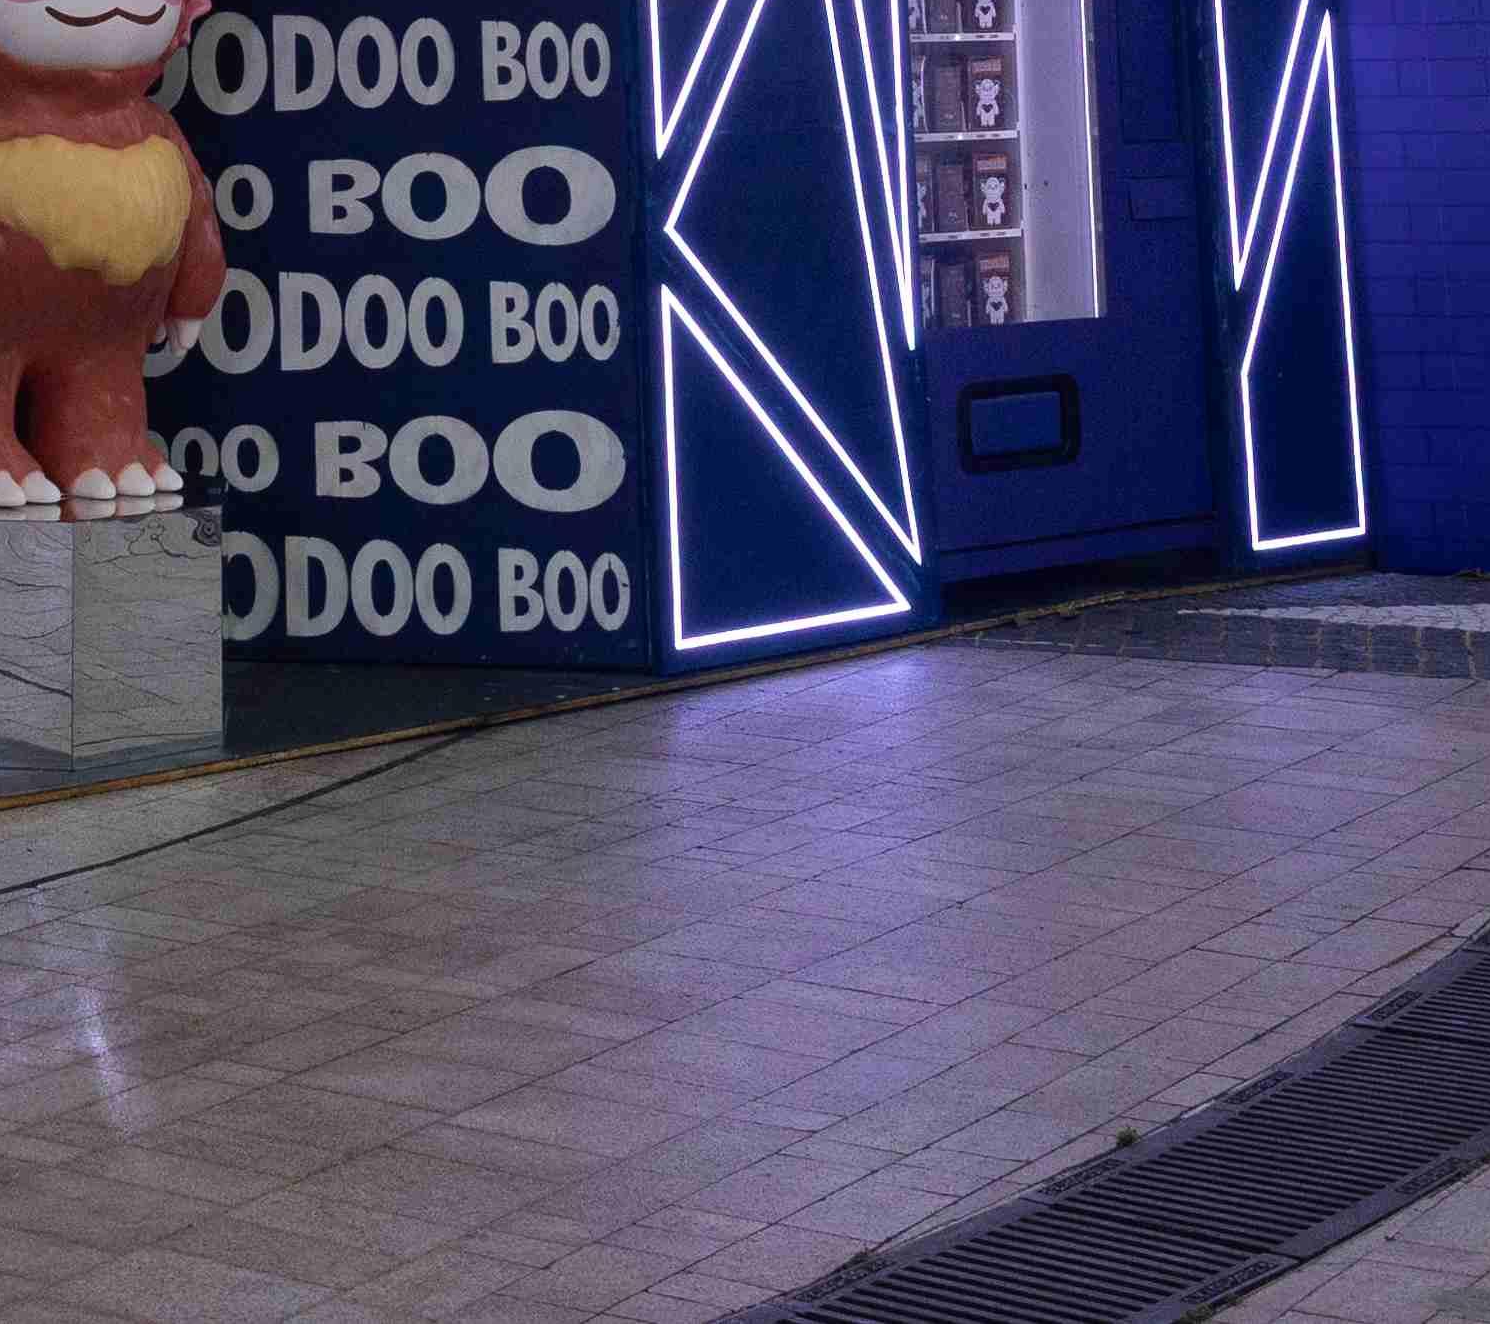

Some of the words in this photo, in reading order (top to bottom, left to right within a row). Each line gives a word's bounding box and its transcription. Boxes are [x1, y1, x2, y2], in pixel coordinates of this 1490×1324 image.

[150, 11, 456, 117] ODOO
[482, 19, 612, 102] BOO
[309, 145, 617, 246] BOO
[490, 280, 621, 365] BOO
[315, 410, 626, 514] BOO
[499, 545, 632, 634] BOO
